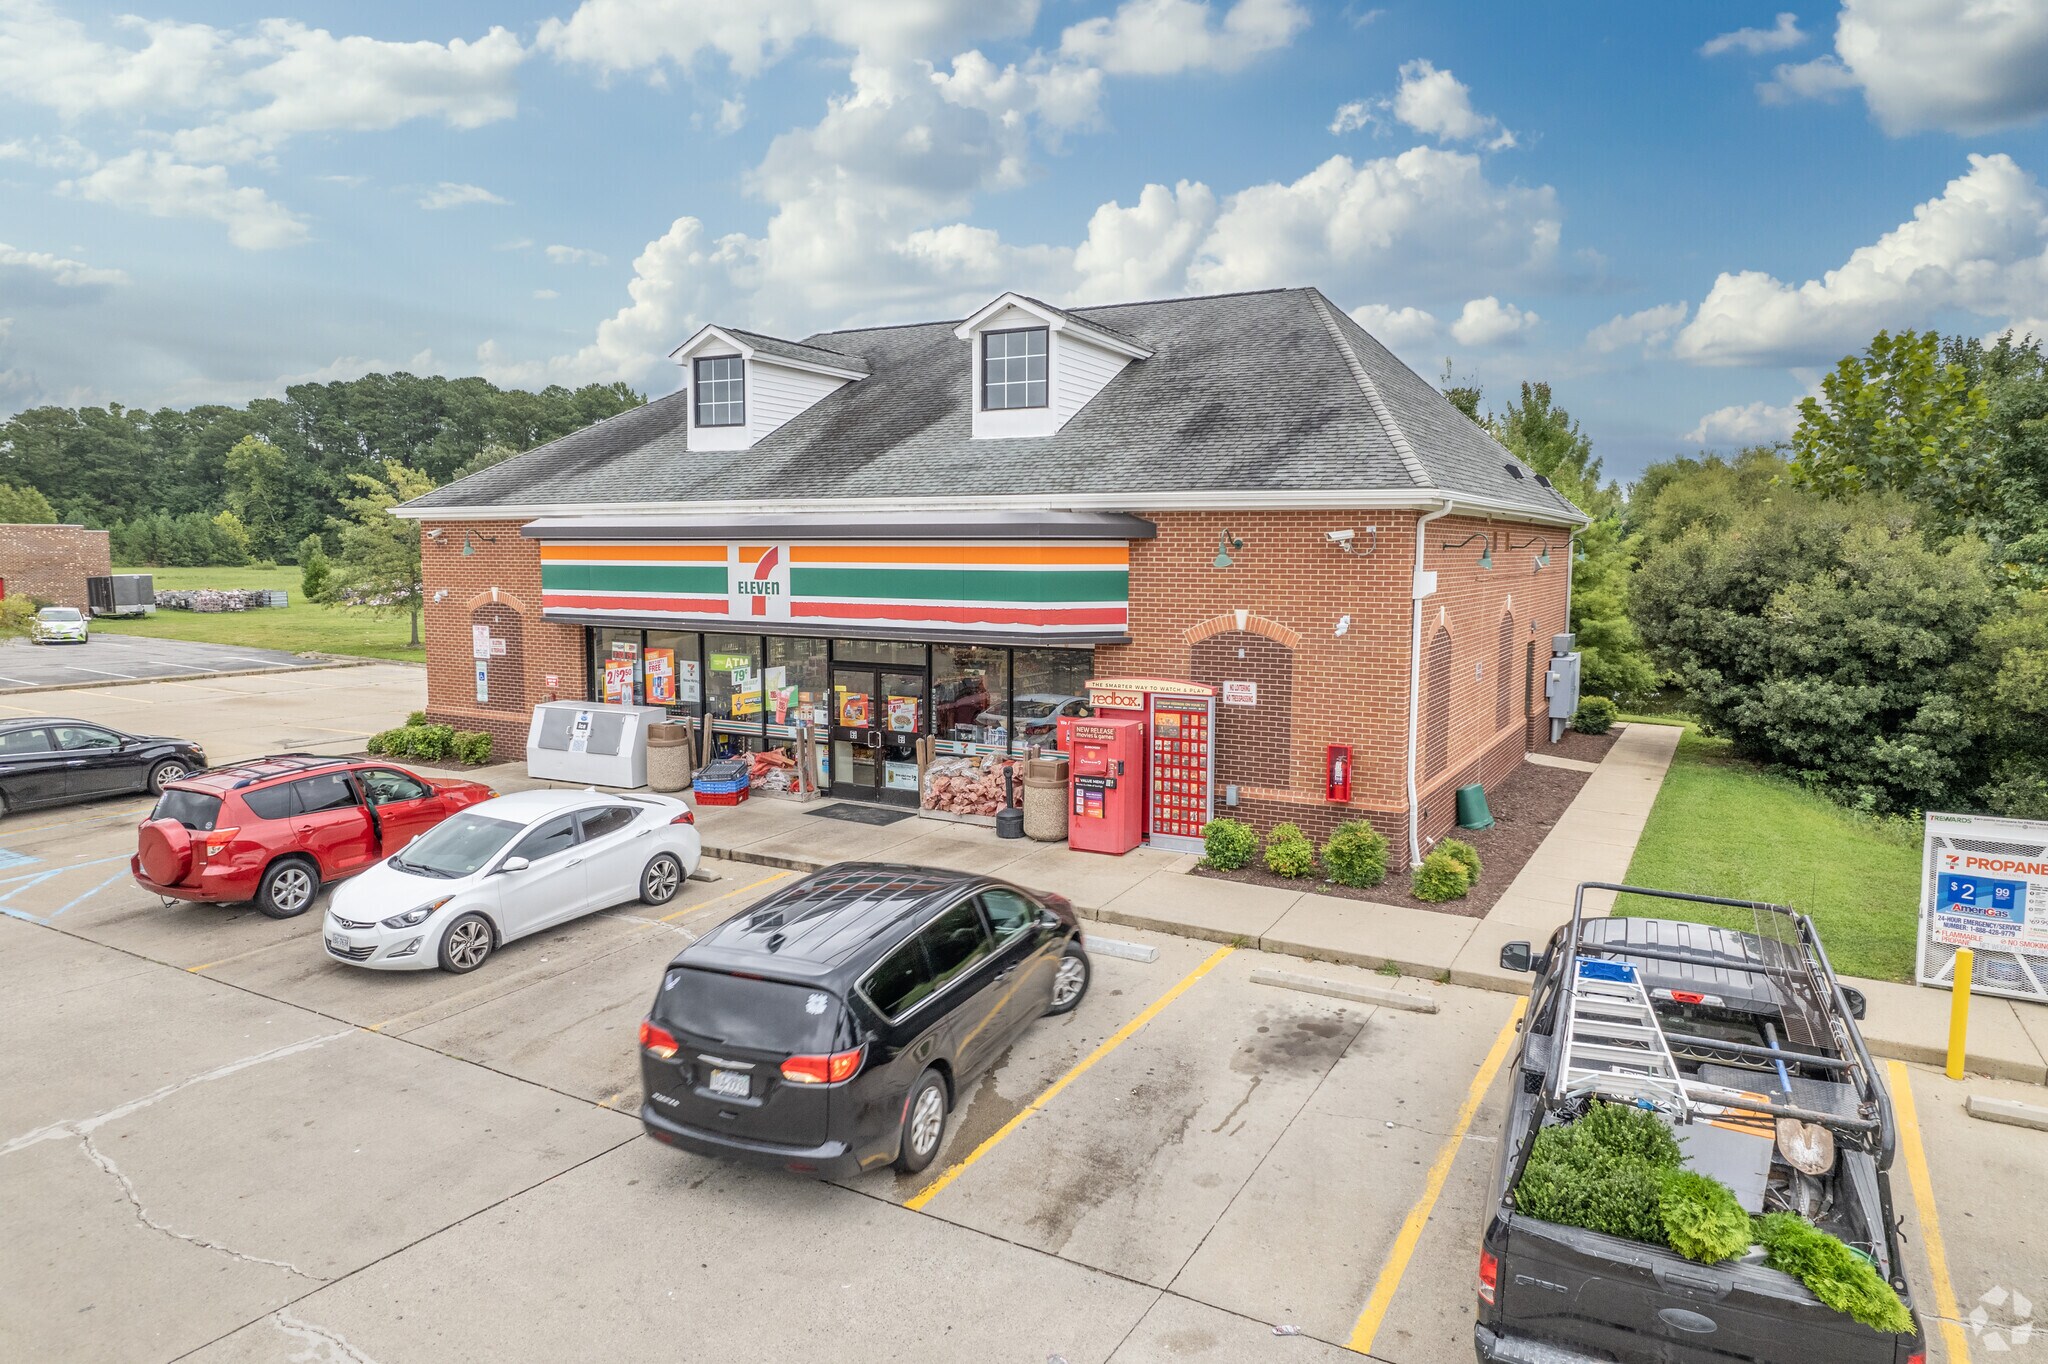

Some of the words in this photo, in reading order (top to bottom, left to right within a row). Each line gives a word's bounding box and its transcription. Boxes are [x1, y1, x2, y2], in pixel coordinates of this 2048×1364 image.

[738, 545, 778, 615] 7
[738, 581, 779, 595] ELEVEN
[648, 663, 661, 673] FREE
[725, 657, 749, 669] ATM
[1090, 727, 1114, 735] RELEASE
[1995, 888, 2010, 897] 99
[1952, 903, 2008, 917] AmeriGas
[1938, 915, 1962, 925] 24-HOUR
[1963, 918, 2022, 932] EMERGENCY/SERVICE
[1943, 922, 1969, 931] NUMBER:
[1941, 930, 1984, 942] FLAMMABLE
[1941, 936, 1970, 946] PROPANE
[2008, 939, 2018, 947] NO
